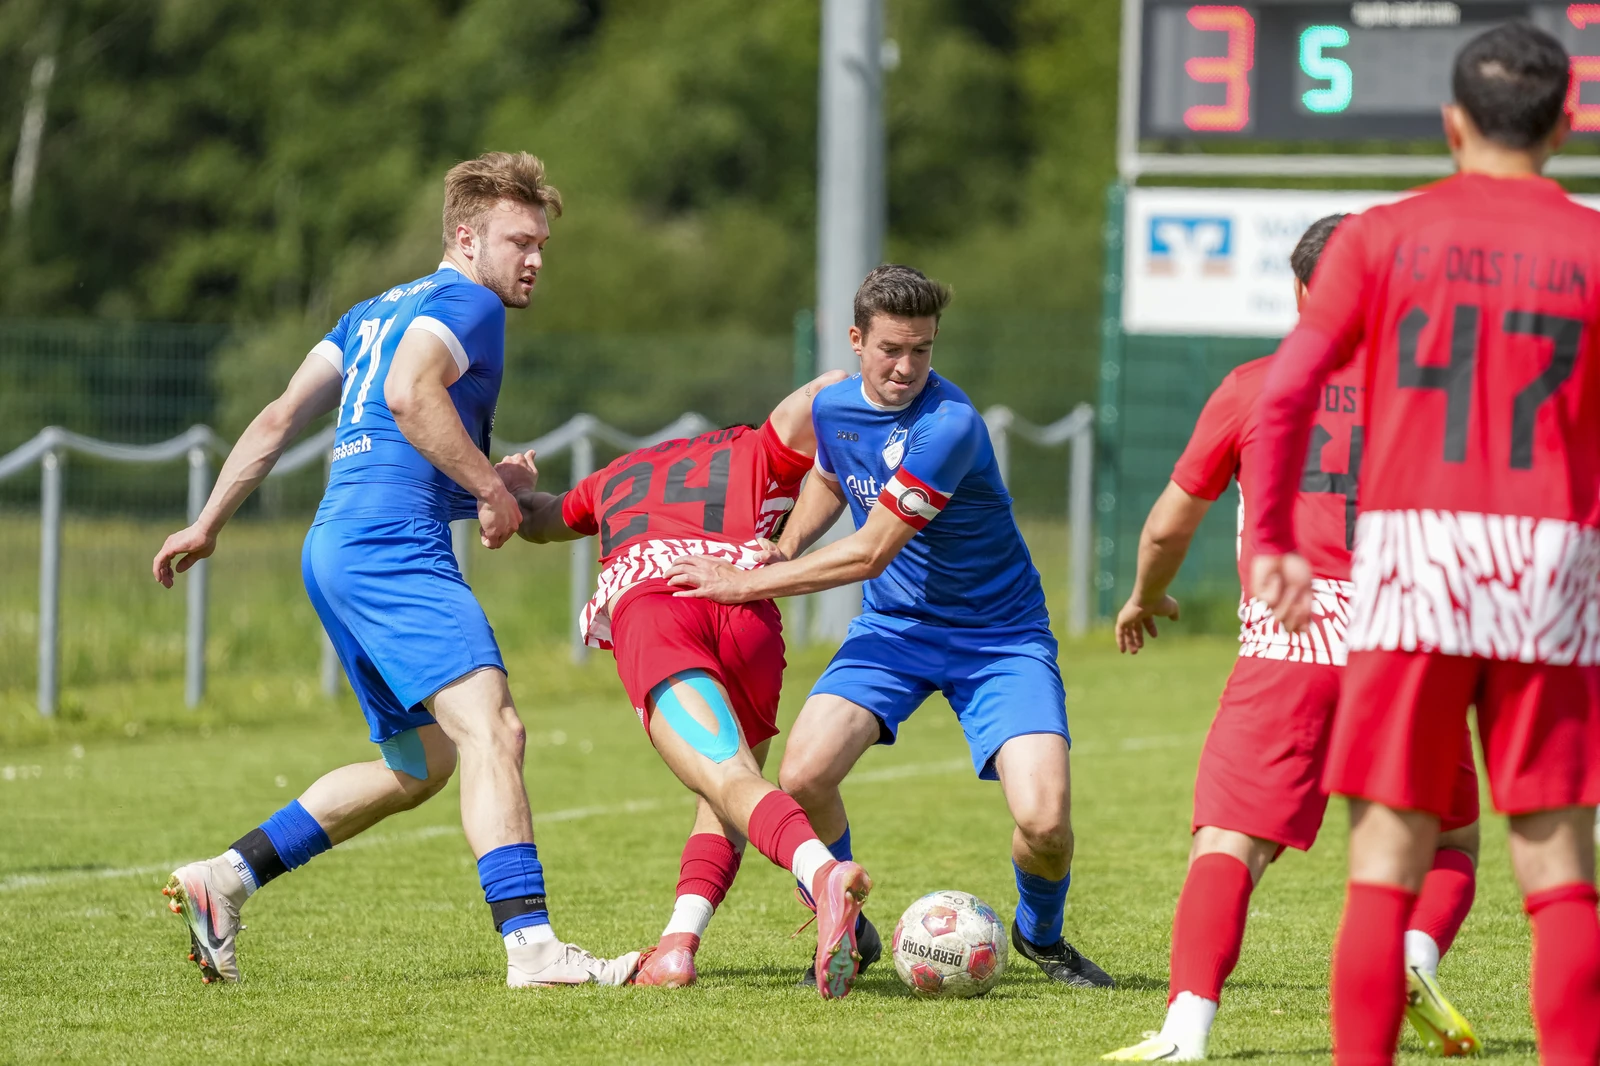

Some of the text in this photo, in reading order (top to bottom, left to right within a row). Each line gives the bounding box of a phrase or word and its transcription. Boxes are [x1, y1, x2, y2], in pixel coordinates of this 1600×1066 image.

[1183, 4, 1255, 132] 3
[1397, 303, 1585, 471] 47
[600, 448, 732, 558] 24
[896, 486, 931, 518] C
[902, 938, 964, 967] DERBYSTAR
